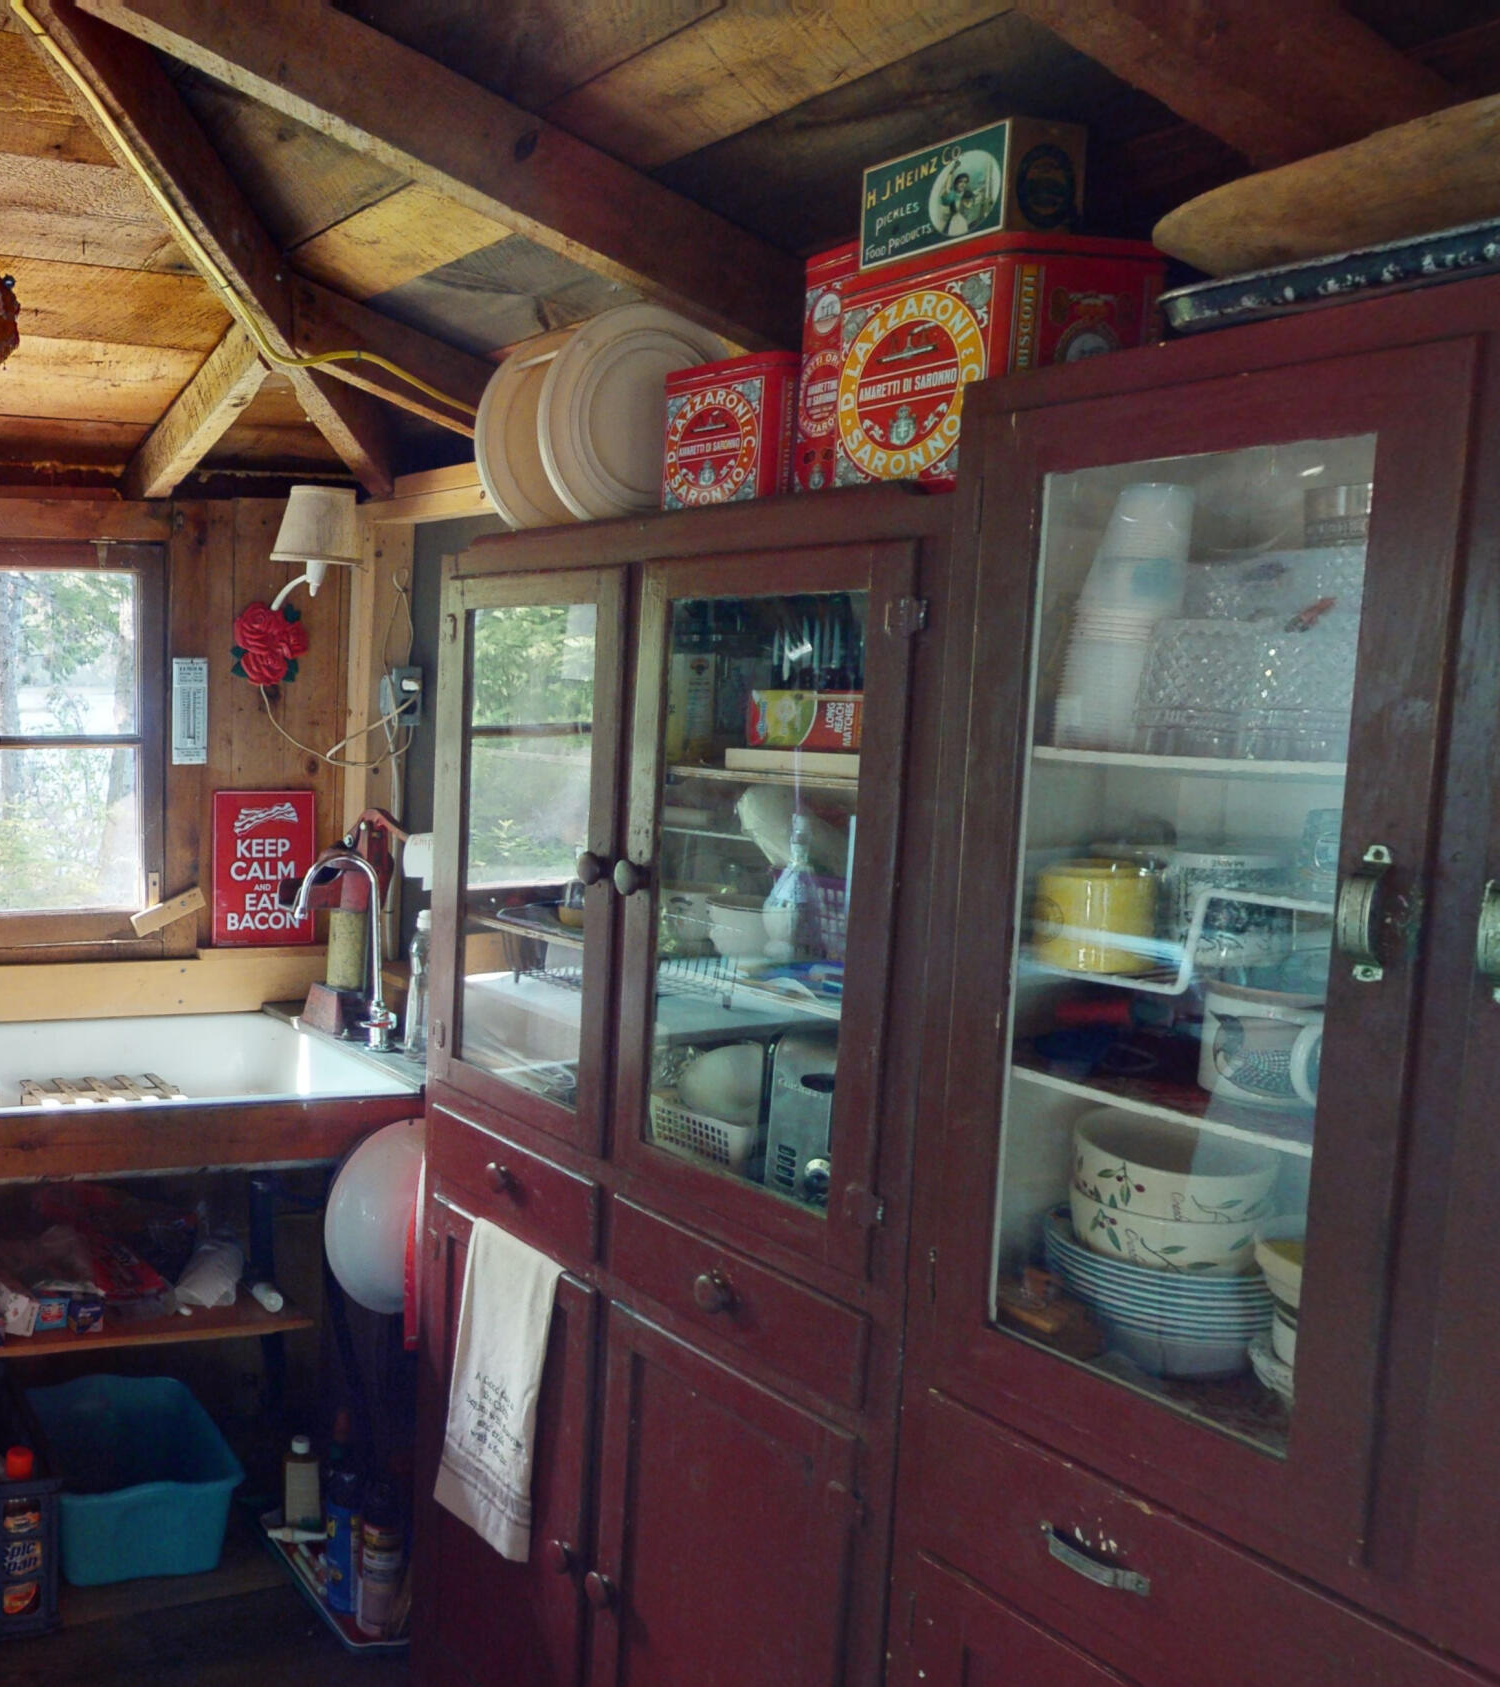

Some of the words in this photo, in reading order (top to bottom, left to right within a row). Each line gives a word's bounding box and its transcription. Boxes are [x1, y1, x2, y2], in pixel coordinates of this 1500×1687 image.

[875, 201, 920, 236] PICKLES
[887, 222, 932, 255] PRODUCTS
[846, 294, 975, 377] LAZZARONI
[859, 383, 900, 402] AMARETTI
[902, 380, 910, 392] DI
[914, 368, 958, 391] SARONNO
[670, 391, 749, 441] LAZZARONI
[679, 442, 705, 457] AMARETTI
[847, 415, 961, 475] SARONNO
[671, 467, 744, 504] SARONNO
[825, 702, 836, 728] LONG
[834, 702, 845, 734] REACH
[842, 702, 855, 747] MATCHES
[236, 838, 290, 858] KEEP
[230, 861, 296, 881] CALM
[254, 883, 272, 892] AND
[226, 912, 301, 932] BACON
